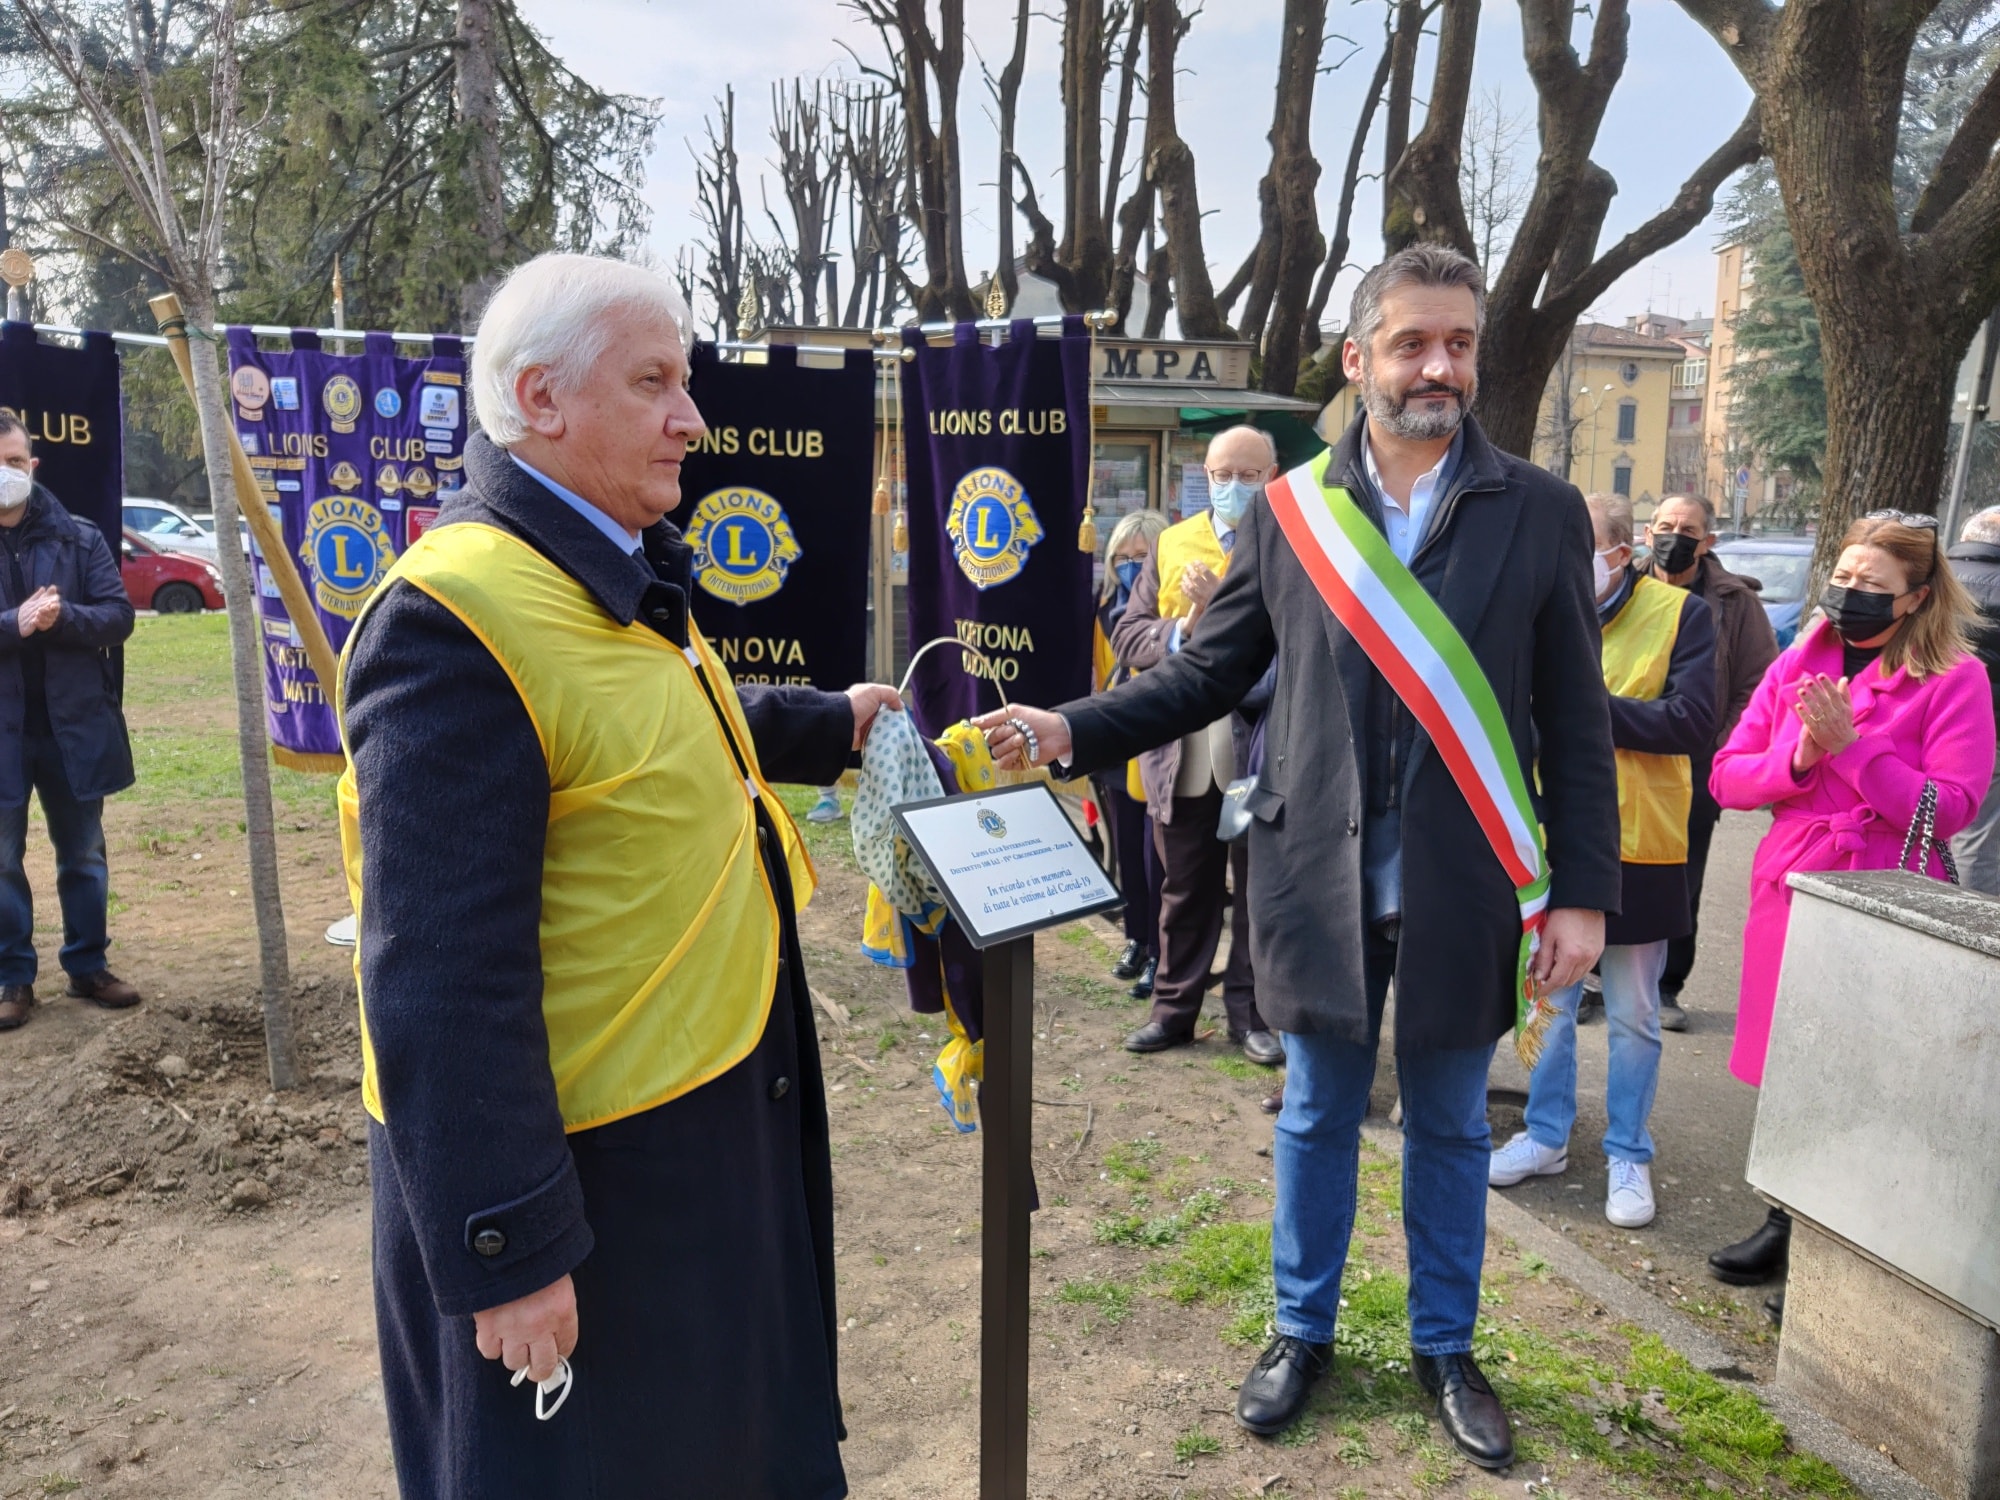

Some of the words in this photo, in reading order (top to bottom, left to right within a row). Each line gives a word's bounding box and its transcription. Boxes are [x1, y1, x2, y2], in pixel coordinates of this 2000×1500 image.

[1103, 348, 1217, 381] MPA
[929, 408, 992, 436] LIONS
[999, 407, 1067, 436] CLUB
[268, 432, 329, 458] LIONS
[369, 435, 426, 462] CLUB
[748, 427, 825, 458] CLUB
[962, 467, 1017, 500] LIONS
[312, 500, 377, 528] LIONS
[706, 492, 775, 518] LIONS
[973, 506, 999, 549] L
[331, 534, 364, 578] L
[725, 525, 757, 566] L
[958, 555, 1015, 581] INTERNATIONAL
[707, 573, 775, 597] INTERNATIONAL
[954, 618, 1035, 653] TORTONA
[704, 637, 806, 666] NOVA
[282, 677, 326, 705] MATT
[983, 903, 993, 914] di
[992, 899, 1011, 911] tutte
[1011, 896, 1019, 906] le
[1019, 893, 1045, 903] vittime
[1046, 885, 1057, 897] del
[1057, 876, 1092, 893] Covid-19
[986, 885, 998, 897] In
[998, 878, 1026, 893] ricordo
[1032, 875, 1041, 885] in
[1041, 867, 1073, 883] memoria
